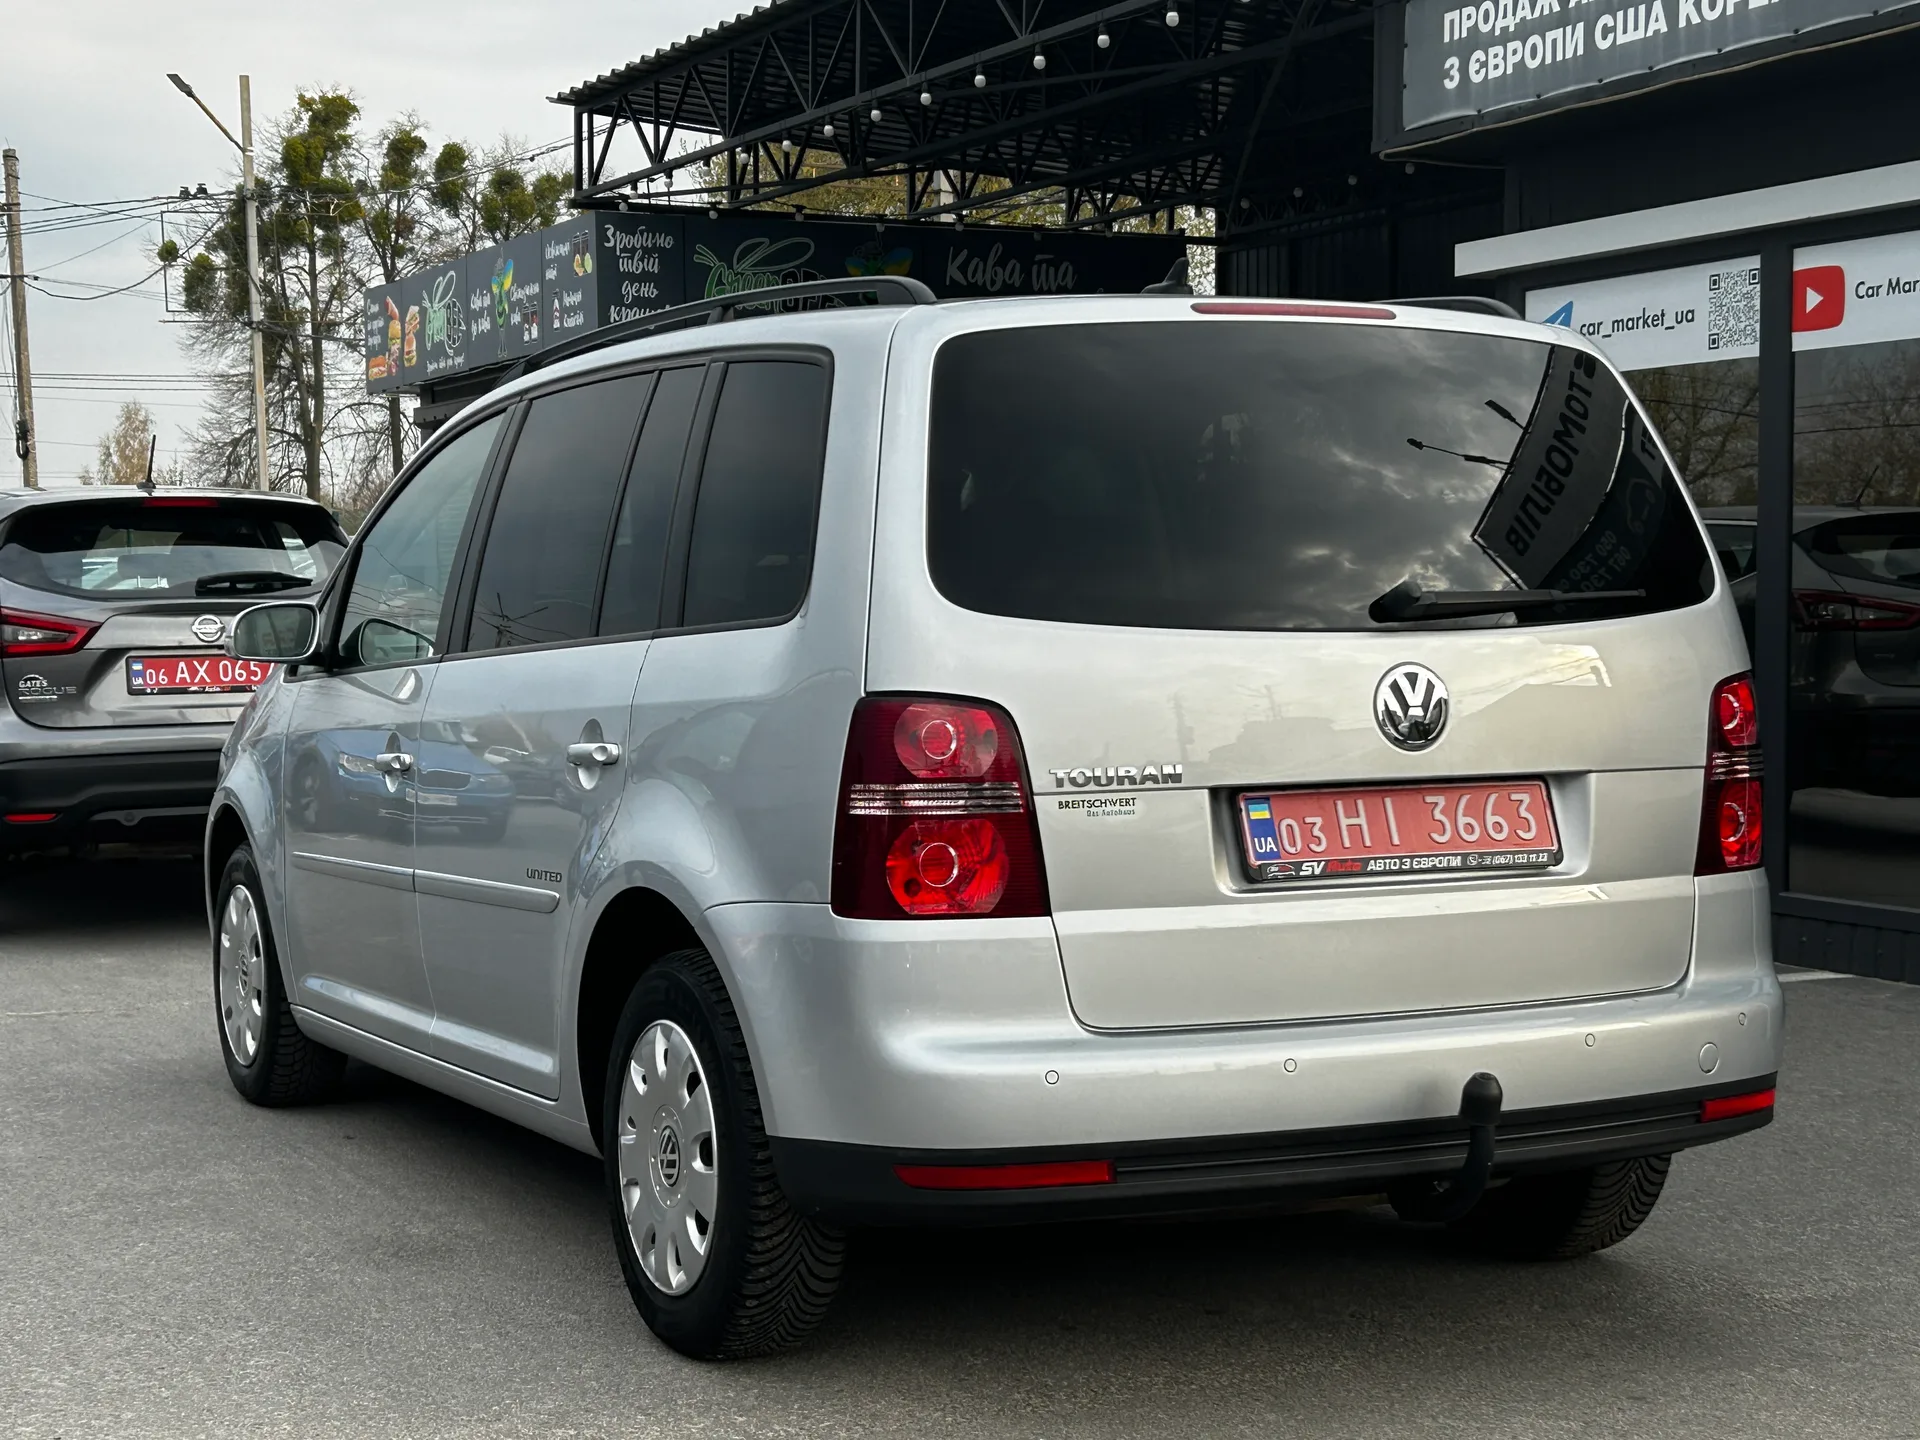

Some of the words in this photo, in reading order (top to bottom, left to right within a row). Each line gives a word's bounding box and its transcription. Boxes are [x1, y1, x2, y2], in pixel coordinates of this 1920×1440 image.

[1443, 56, 1460, 90] З
[1468, 21, 1585, 84] ЄВРОПИ
[1594, 3, 1668, 50] США
[604, 224, 674, 256] Зробимо
[946, 242, 1024, 292] Кава
[621, 280, 659, 304] день
[1854, 281, 1884, 300] Car
[1580, 307, 1696, 339] car_market_ua
[145, 668, 169, 685] 06
[175, 660, 212, 684] AX
[1049, 763, 1184, 789] TOURAN
[1279, 816, 1328, 855] 03
[1423, 792, 1538, 844] 3663
[1254, 837, 1278, 853] UA
[526, 867, 562, 883] UNITED
[1299, 861, 1326, 876] SV
[1366, 858, 1400, 871] АВТО
